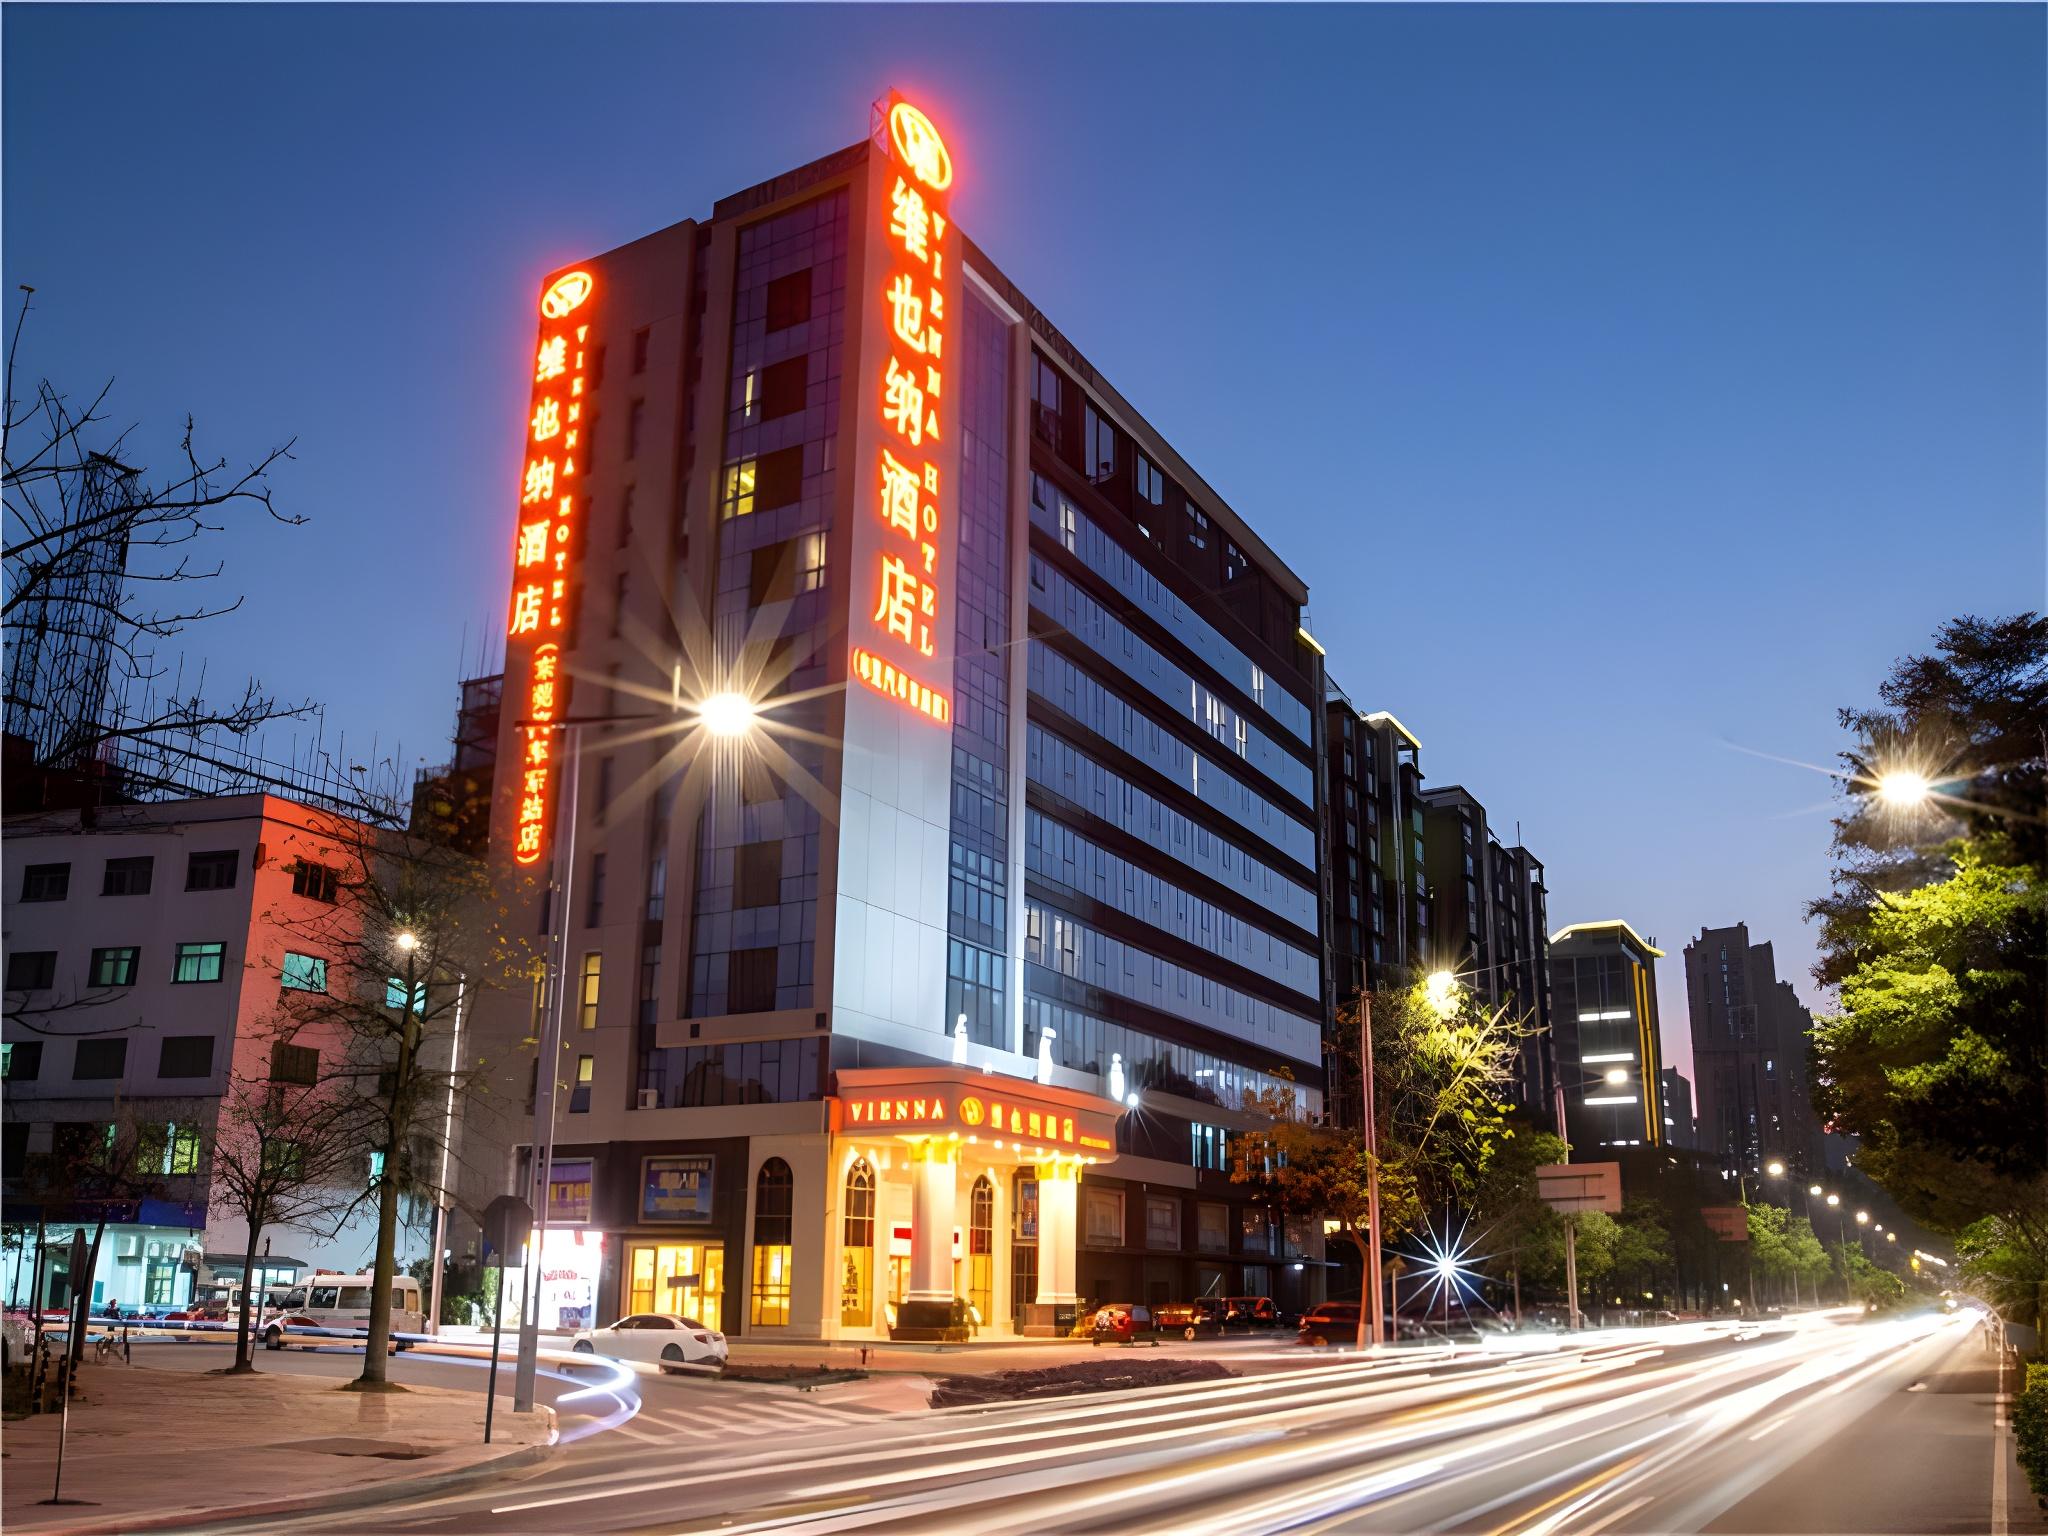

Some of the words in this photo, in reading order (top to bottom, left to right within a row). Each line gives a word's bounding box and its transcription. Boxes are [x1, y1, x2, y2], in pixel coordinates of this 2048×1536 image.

[874, 175, 929, 645] 维也纳酒店
[926, 210, 946, 440] VIENNA
[509, 335, 568, 635] 维也纳酒店
[550, 495, 571, 627] HOTEL
[920, 461, 939, 657] HOTEL
[851, 1098, 945, 1122] VIENNA
